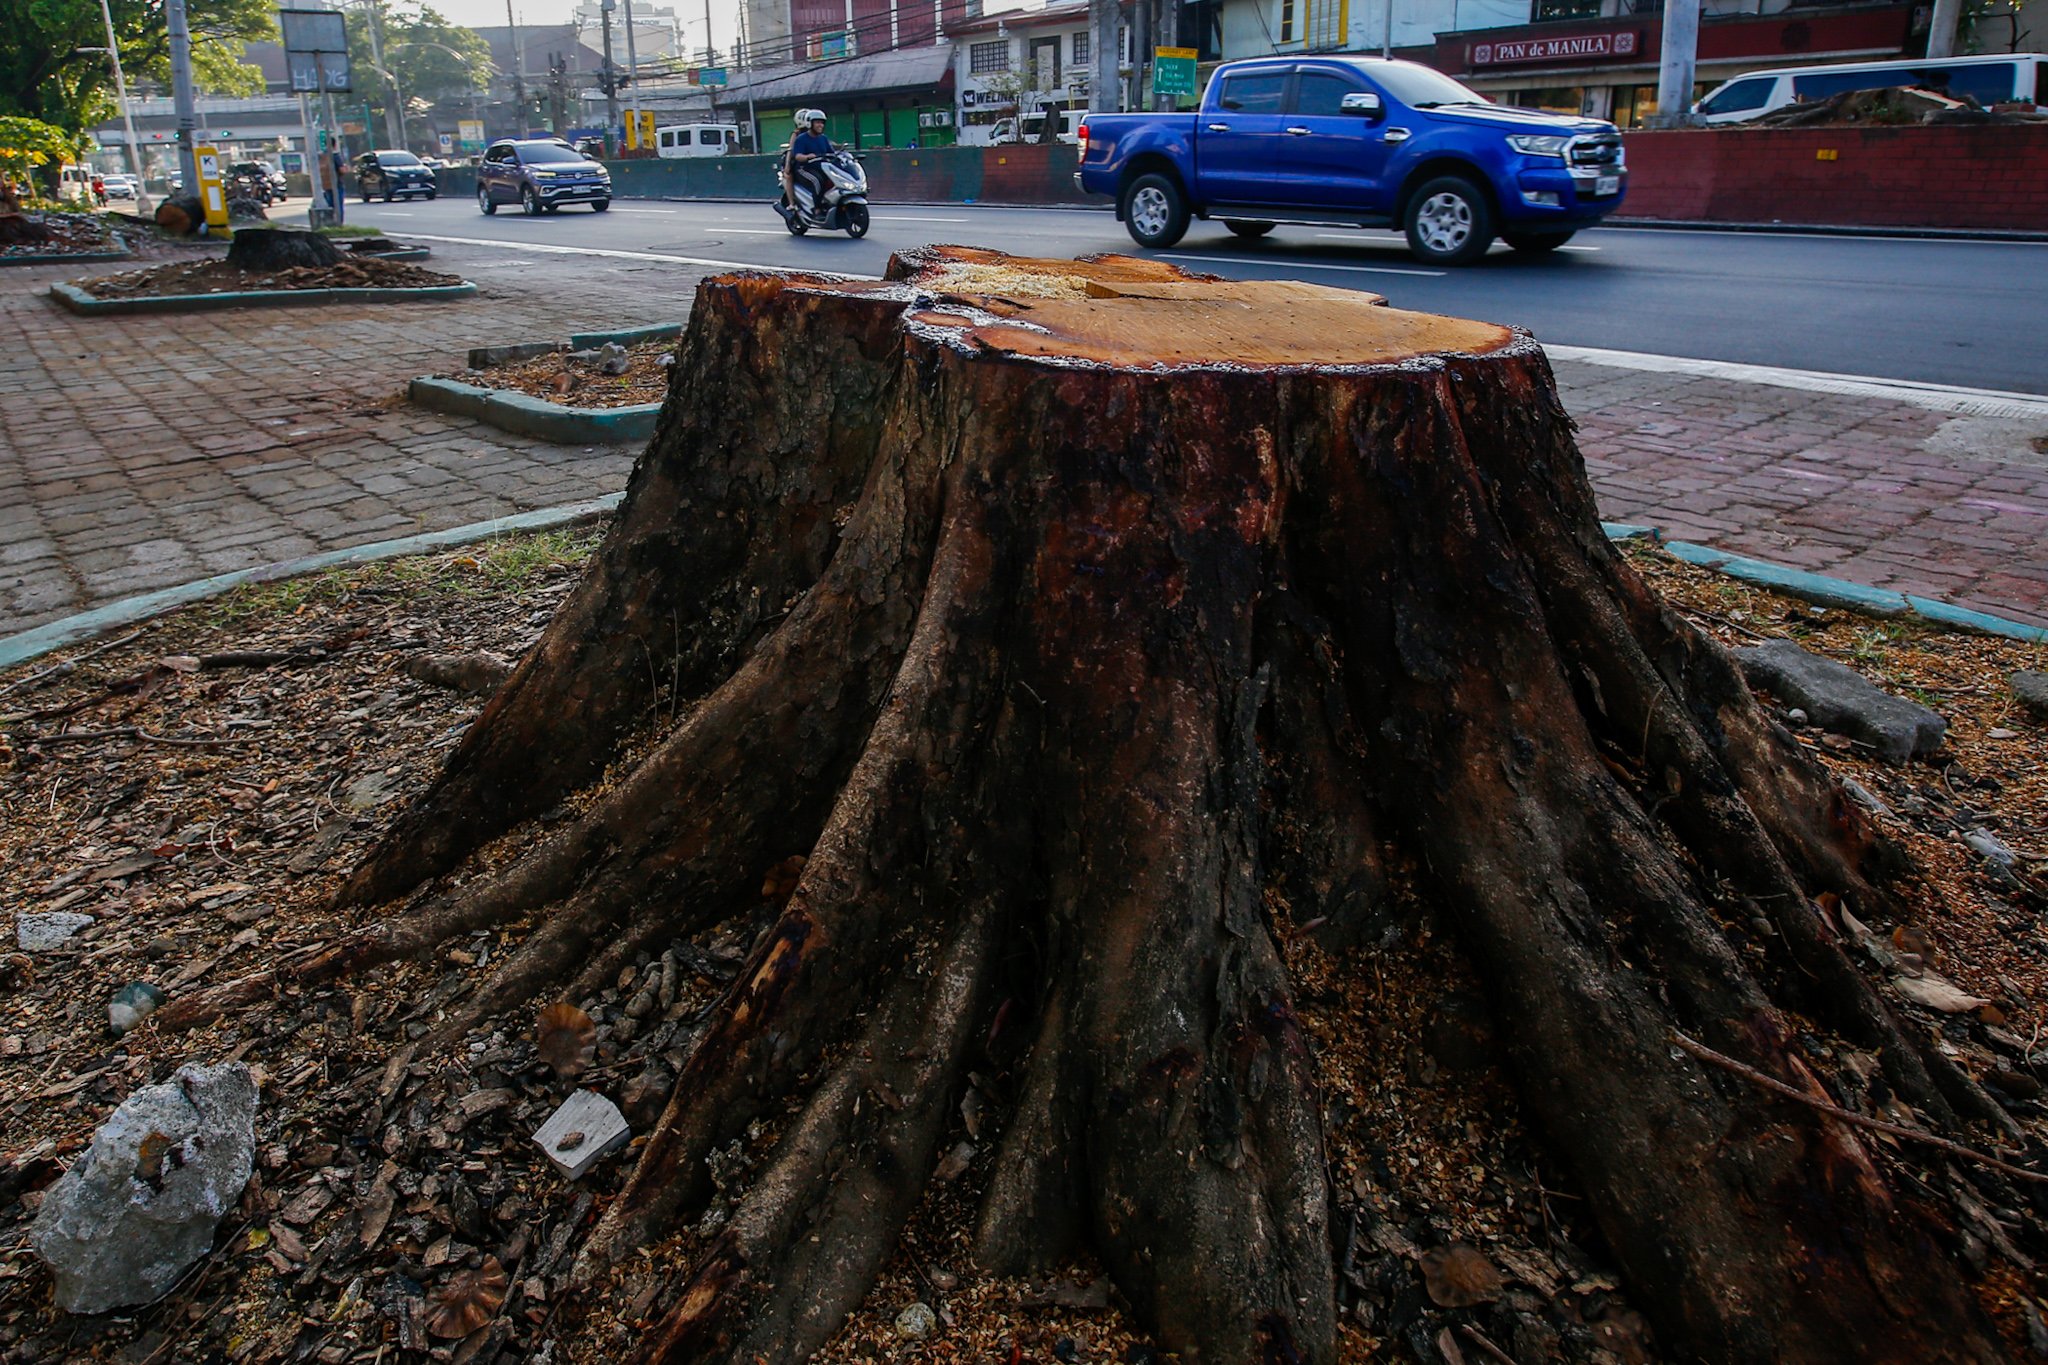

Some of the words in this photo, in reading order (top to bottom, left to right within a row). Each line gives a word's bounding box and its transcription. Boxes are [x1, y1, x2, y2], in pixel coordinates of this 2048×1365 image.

[1500, 45, 1525, 58] PAN
[1529, 43, 1544, 56] de
[1547, 38, 1604, 55] MANILA
